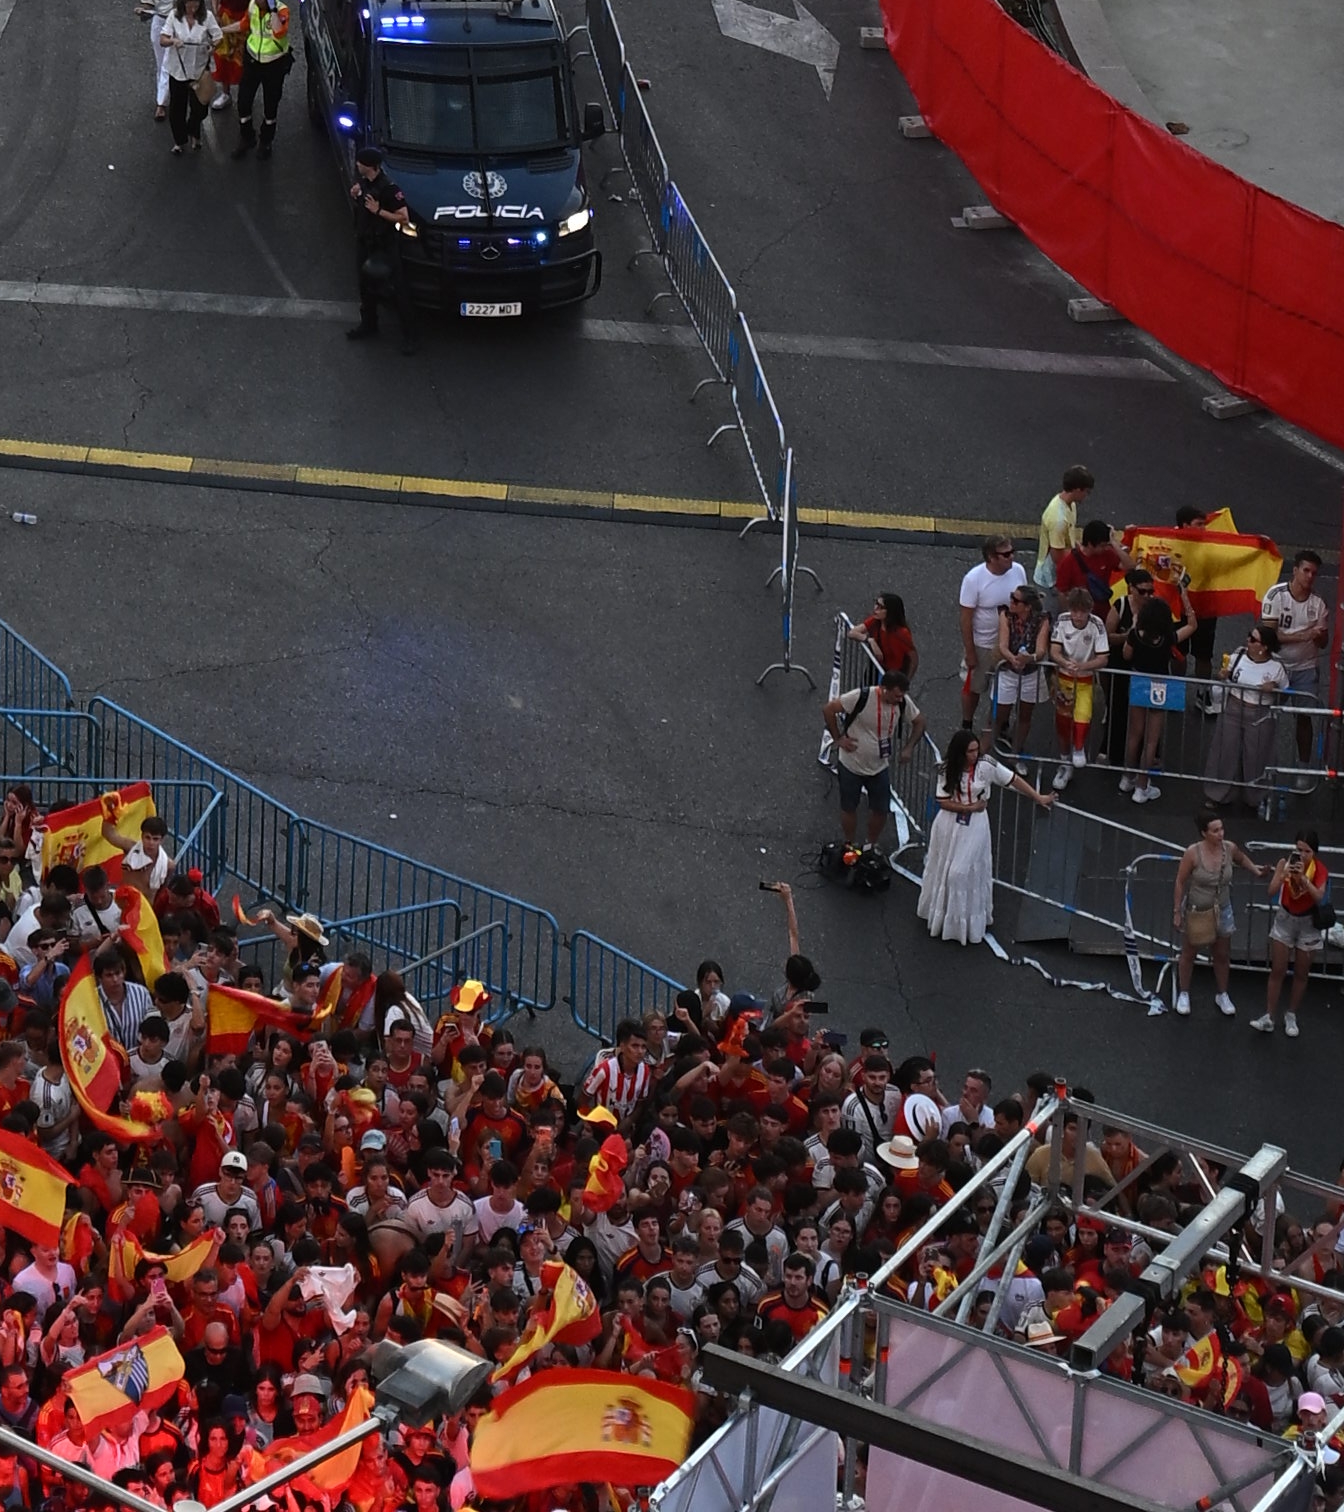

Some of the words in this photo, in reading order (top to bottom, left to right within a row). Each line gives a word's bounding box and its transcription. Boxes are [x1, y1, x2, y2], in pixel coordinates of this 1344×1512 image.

[468, 305, 495, 315] 2227
[499, 304, 518, 315] MDT
[1279, 613, 1292, 629] 19
